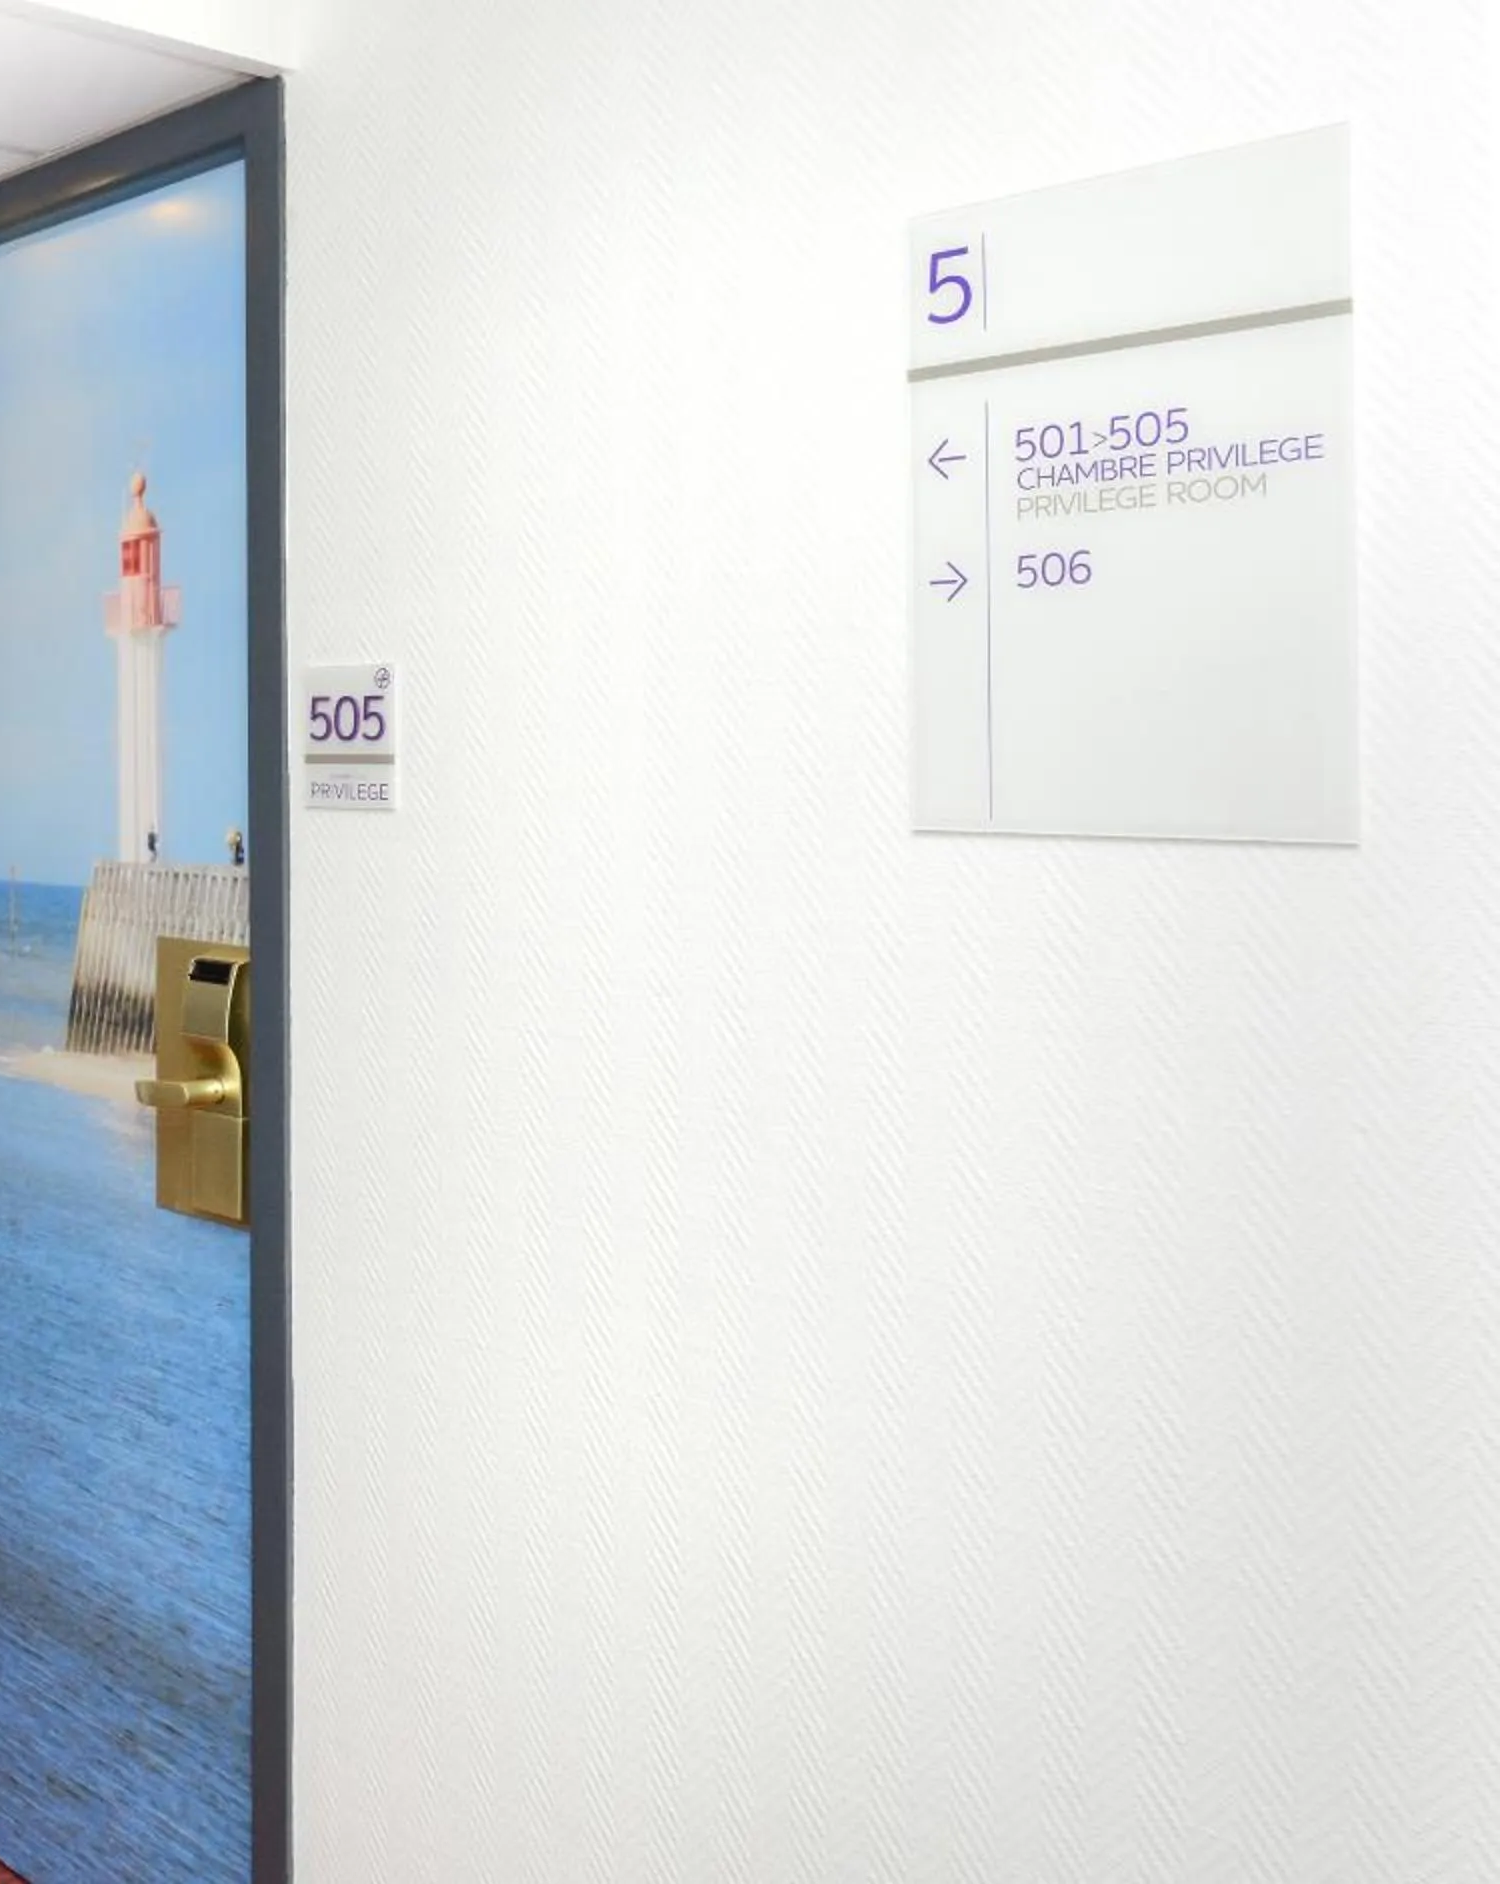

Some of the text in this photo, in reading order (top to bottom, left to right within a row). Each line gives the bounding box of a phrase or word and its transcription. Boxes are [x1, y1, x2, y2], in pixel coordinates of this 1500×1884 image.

[927, 246, 972, 325] 5
[1016, 433, 1325, 491] CHAMBRE PRIVILEGE
[1016, 473, 1268, 521] PRIVILEGE ROOM
[1016, 549, 1092, 588] 506
[309, 695, 386, 742] 505
[310, 782, 389, 801] PRIVILEGE
